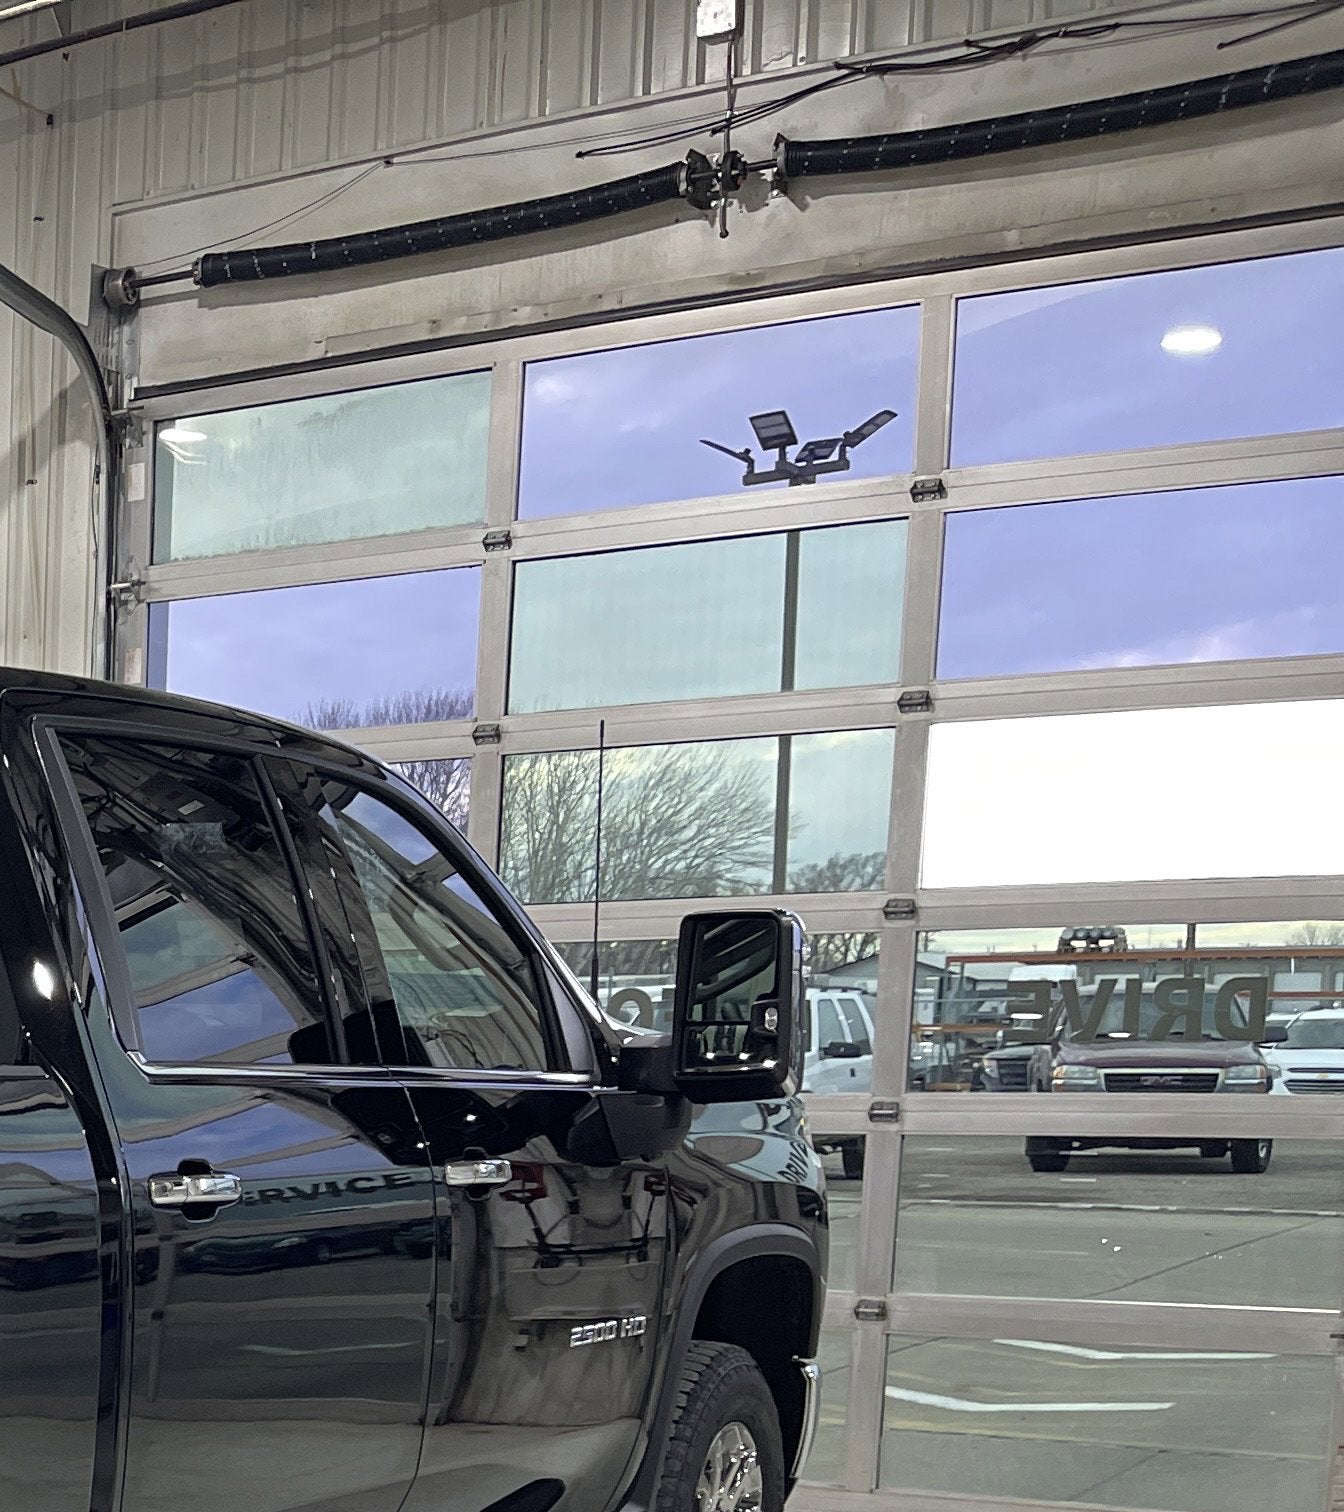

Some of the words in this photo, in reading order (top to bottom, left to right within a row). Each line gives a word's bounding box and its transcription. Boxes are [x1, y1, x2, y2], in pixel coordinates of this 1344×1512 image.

[242, 1172, 413, 1206] ERVICE
[570, 1320, 617, 1348] 2500
[620, 1316, 647, 1338] HD
